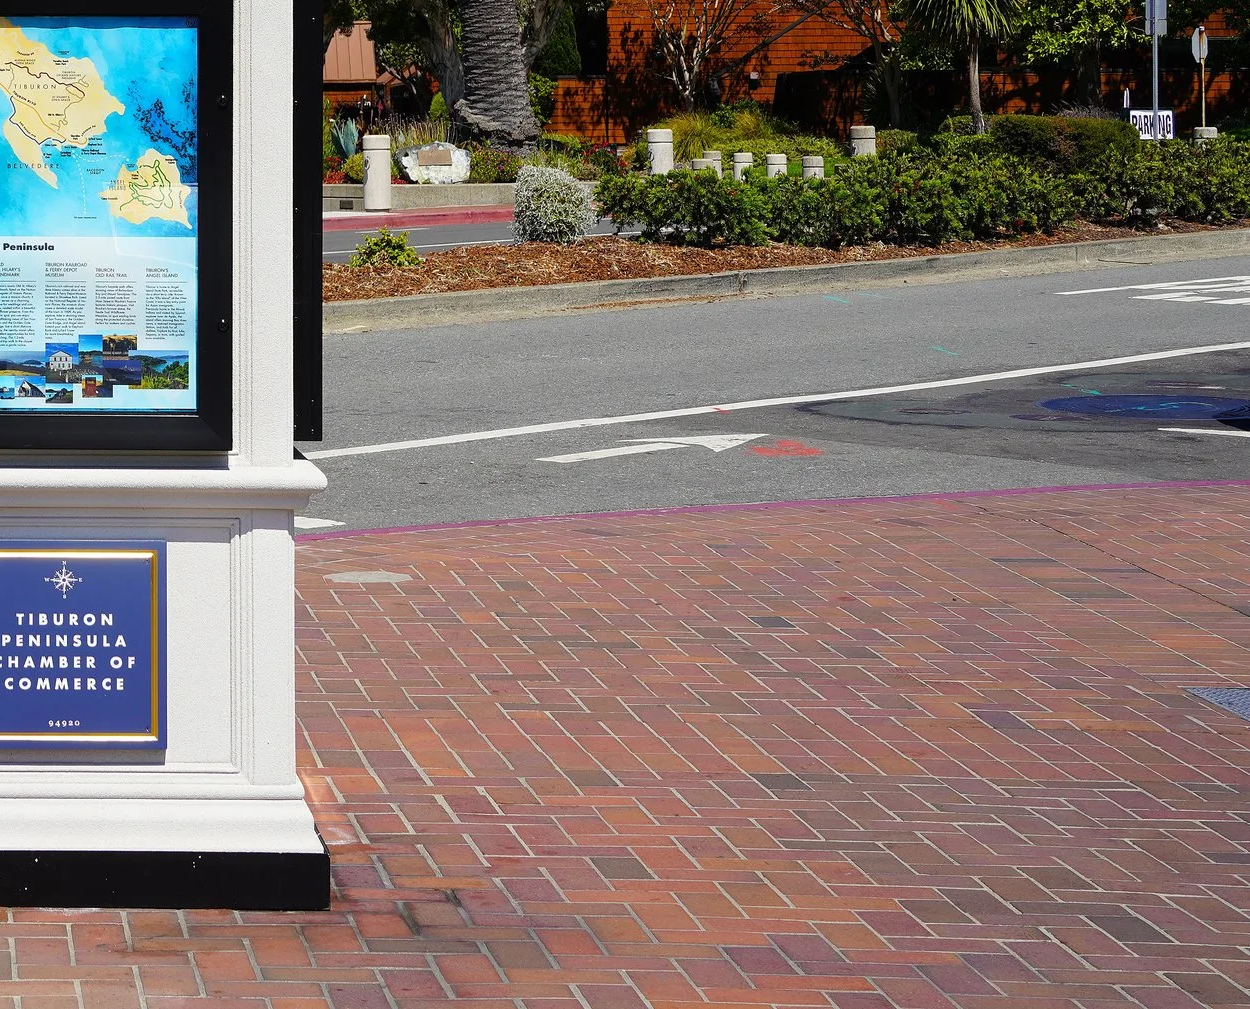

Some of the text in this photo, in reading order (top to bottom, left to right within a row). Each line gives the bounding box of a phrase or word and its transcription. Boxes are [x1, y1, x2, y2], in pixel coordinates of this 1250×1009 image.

[1132, 115, 1171, 136] PARKNG
[3, 242, 55, 251] Peninsula
[16, 613, 114, 626] TIBURON
[1, 634, 127, 647] PENINSULA
[110, 656, 136, 669] OF
[4, 677, 125, 690] COMMERCE
[48, 720, 80, 728] 94920
